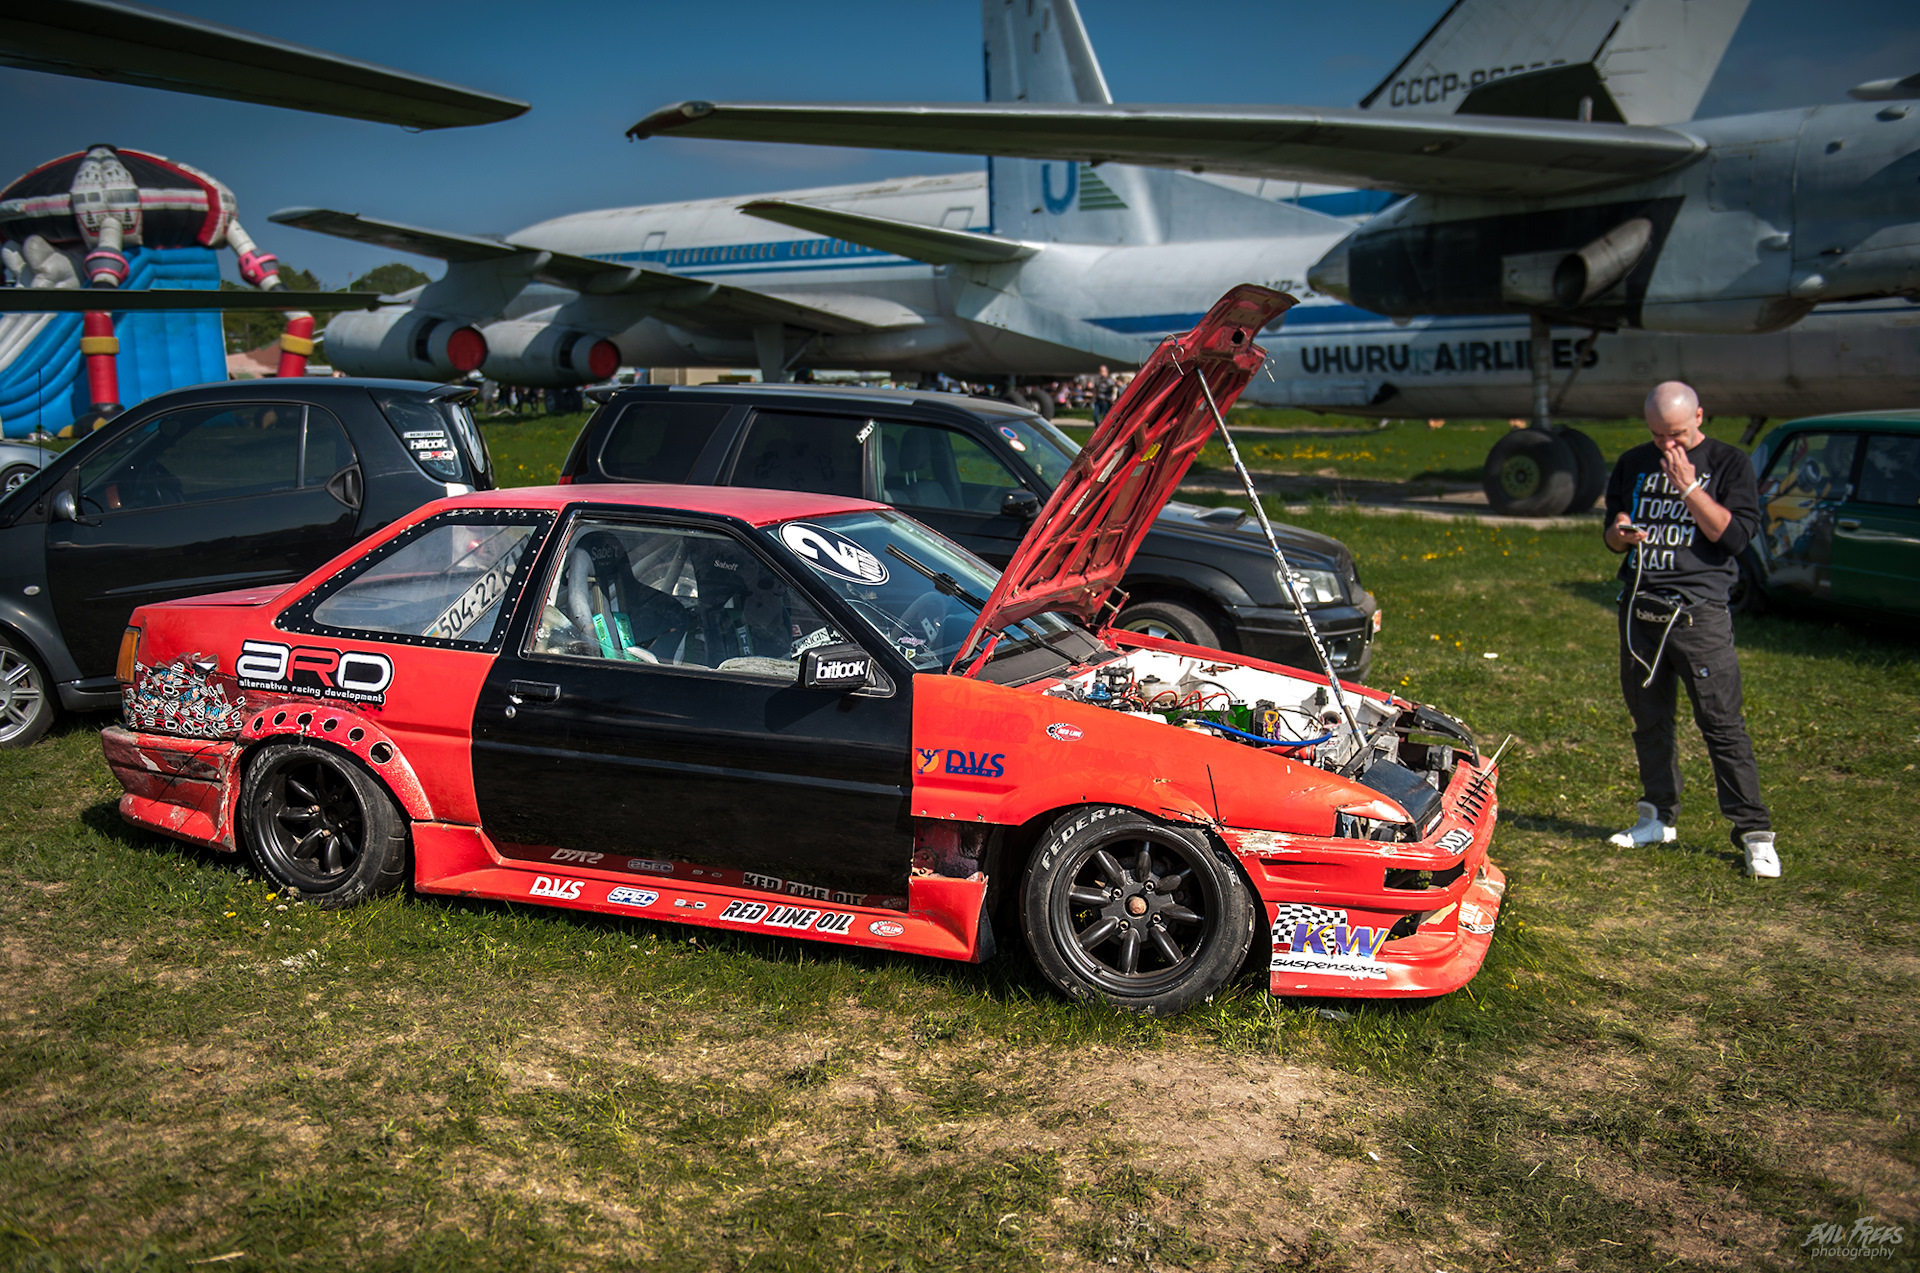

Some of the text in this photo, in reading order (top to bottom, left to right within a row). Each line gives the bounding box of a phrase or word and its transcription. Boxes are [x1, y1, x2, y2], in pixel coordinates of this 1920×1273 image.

[1301, 339, 1599, 374] UHURU AIRLIES
[1644, 473, 1660, 493] Я
[798, 631, 828, 650] ORIGIN
[239, 680, 382, 703] alternative racing development
[946, 750, 1006, 777] DVS
[950, 766, 997, 778] racing
[529, 876, 585, 900] DVS
[611, 887, 656, 903] SPEC
[721, 901, 853, 933] RED LINE OIL
[1291, 922, 1389, 958] KW
